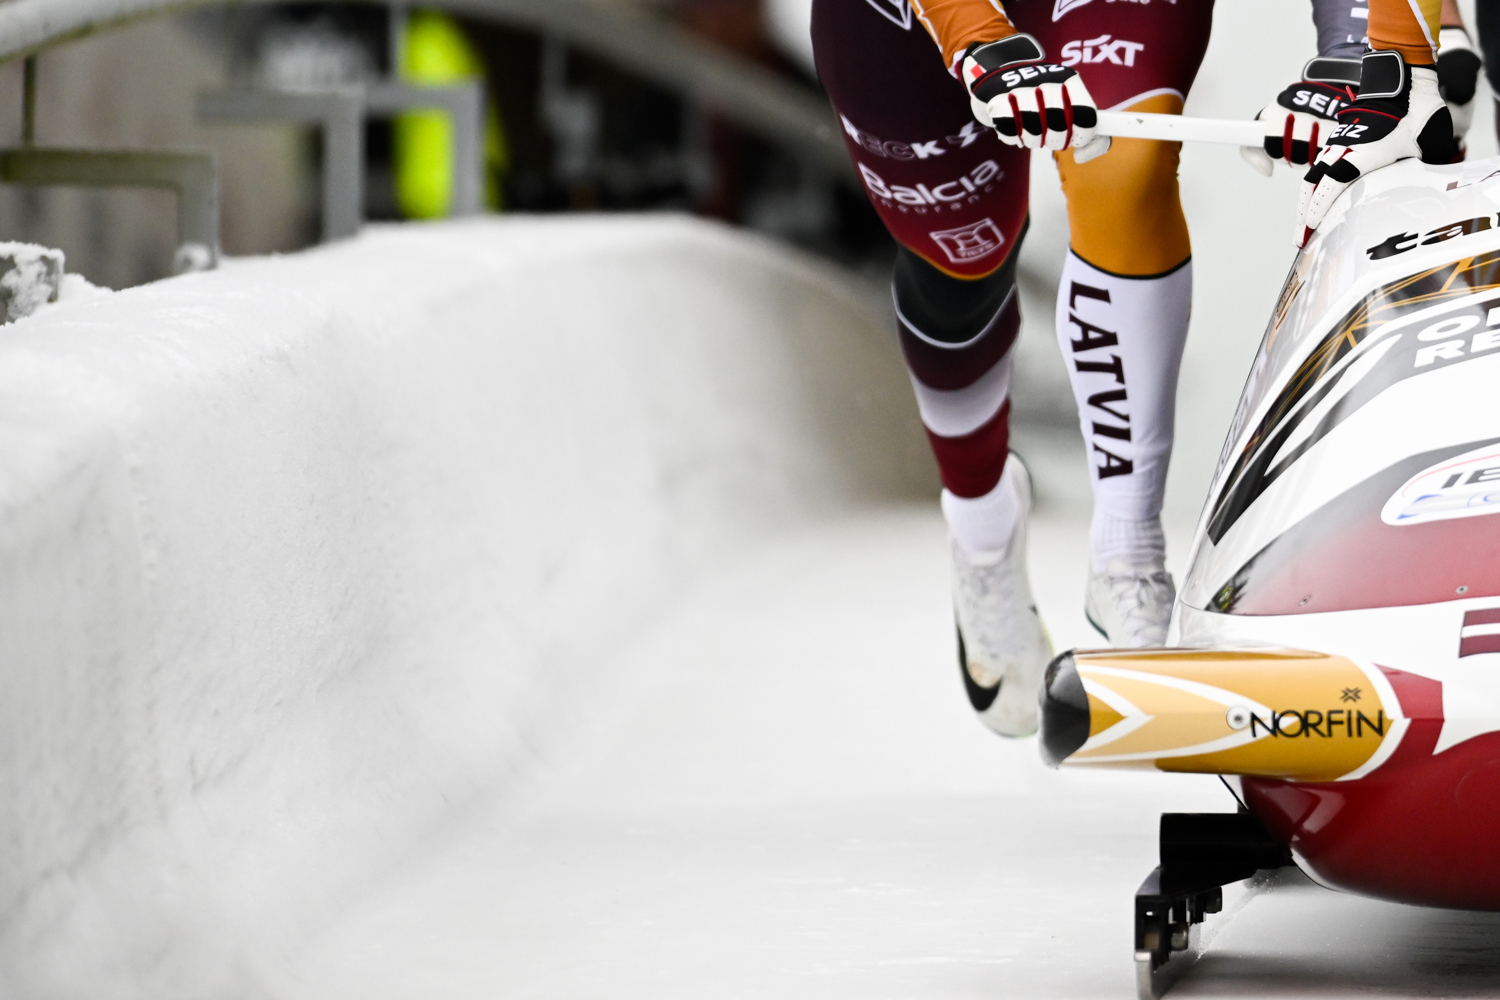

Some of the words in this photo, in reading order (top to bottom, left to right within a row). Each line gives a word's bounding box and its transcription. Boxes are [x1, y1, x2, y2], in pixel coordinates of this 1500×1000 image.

[1001, 62, 1066, 88] SEIZ
[857, 159, 999, 205] Balcia
[1068, 280, 1134, 481] LATVIA
[1250, 709, 1384, 739] NORFIN
